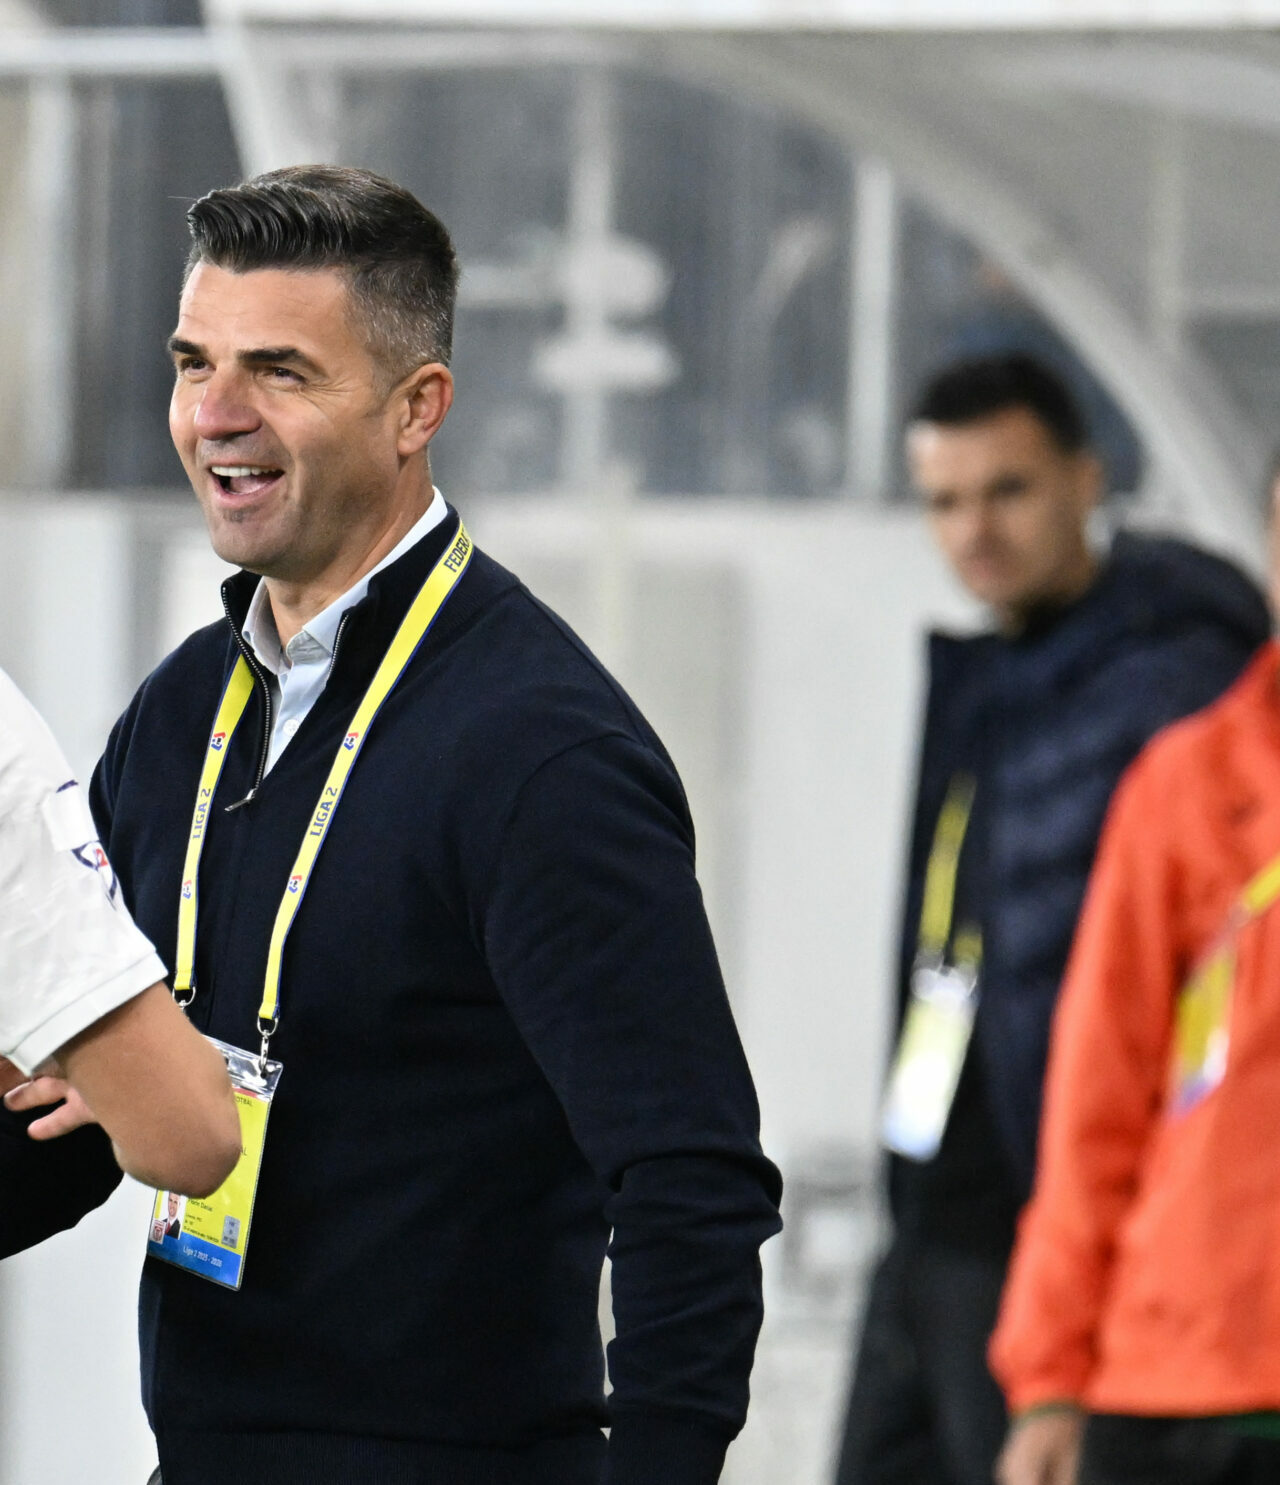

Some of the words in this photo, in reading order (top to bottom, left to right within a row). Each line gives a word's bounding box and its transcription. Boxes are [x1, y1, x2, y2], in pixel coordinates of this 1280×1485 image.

[192, 802, 208, 839] LIGA
[200, 788, 211, 797] 2
[310, 801, 333, 837] LIGA
[325, 786, 338, 797] 2
